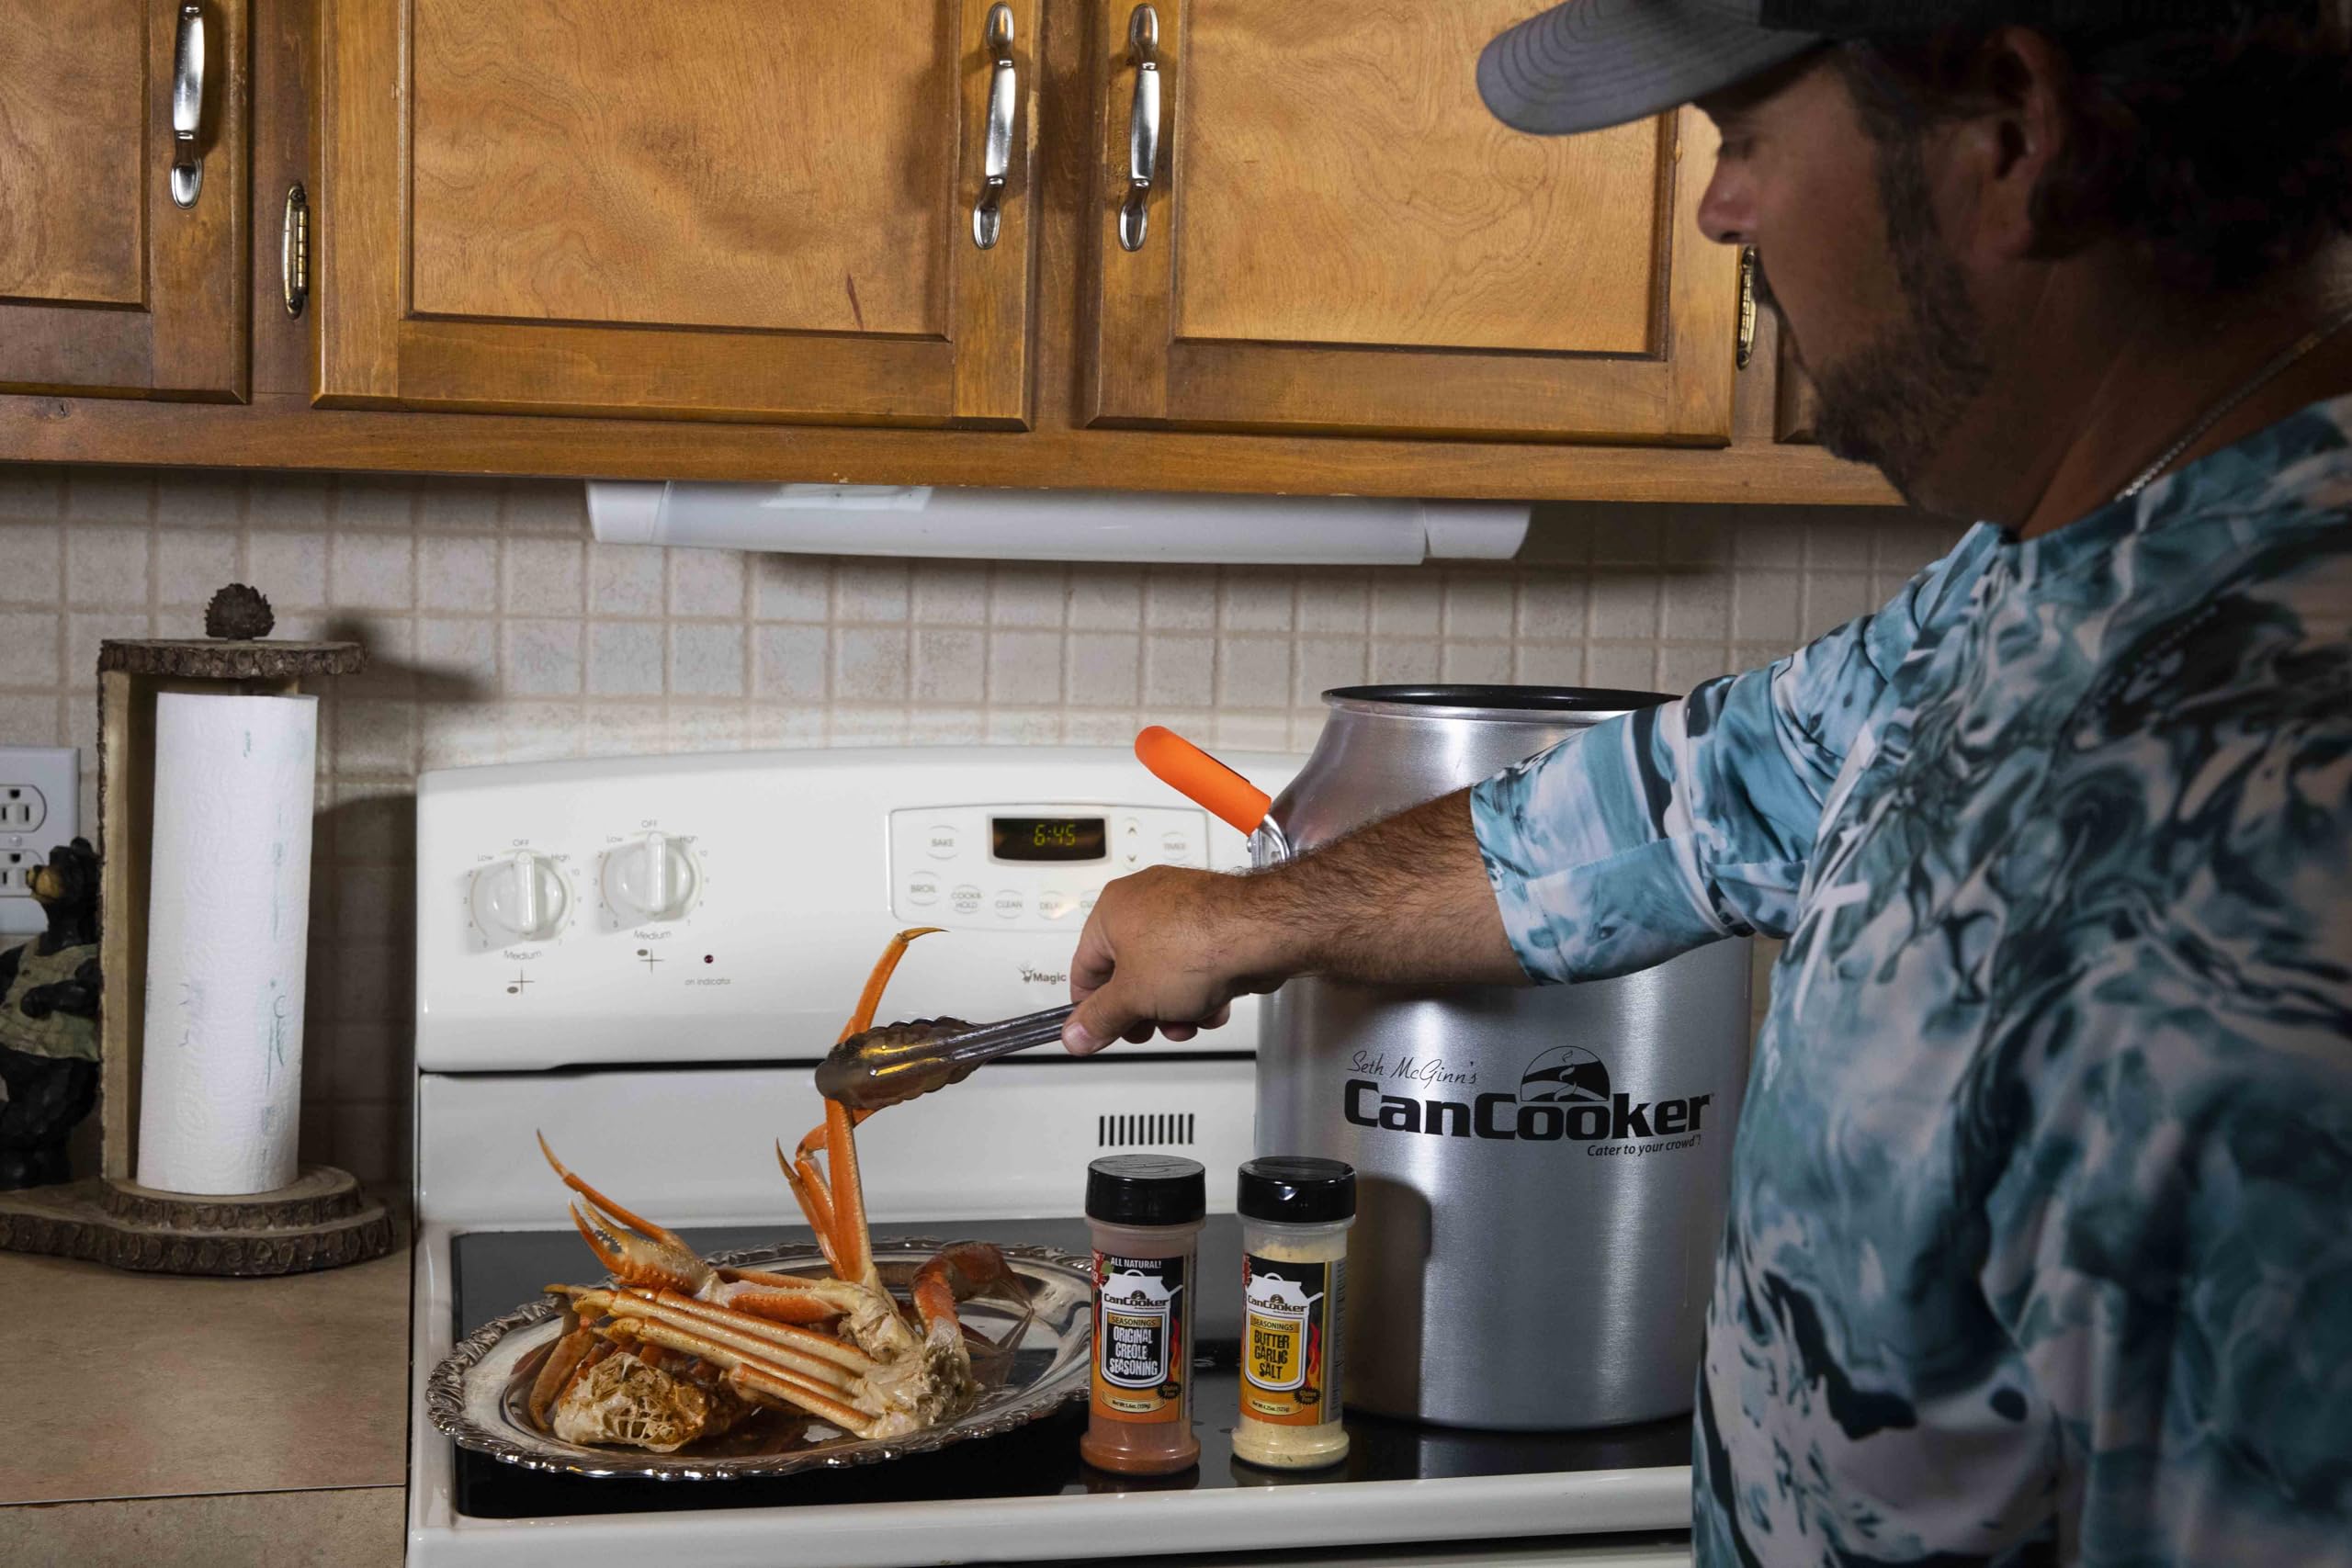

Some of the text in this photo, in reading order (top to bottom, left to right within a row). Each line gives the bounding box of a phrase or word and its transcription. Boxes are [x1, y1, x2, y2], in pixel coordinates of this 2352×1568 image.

[640, 819, 658, 829] OFF
[605, 834, 624, 843] Low
[1033, 824, 1077, 846] 6:45
[512, 838, 531, 847] OFF
[931, 838, 955, 848] BAKE
[477, 853, 495, 863] Low
[910, 884, 937, 894] BROIL
[994, 899, 1023, 909] CLEAN
[632, 929, 672, 941] Medium
[503, 950, 543, 962] Medium
[1032, 971, 1067, 985] Magic
[1347, 1049, 1478, 1089] Seth McGinn's
[1344, 1077, 1713, 1142] CanCooker
[1587, 1145, 1622, 1157] Cater
[1623, 1144, 1636, 1156] to
[1638, 1142, 1664, 1157] your
[1110, 1257, 1162, 1269] ALL NATURAL!
[1104, 1292, 1170, 1307] CanCooker
[1248, 1294, 1308, 1313] CanCooker
[1111, 1315, 1157, 1326] SEASONINGS
[1252, 1318, 1294, 1331] SEASONINGS
[1113, 1326, 1153, 1344] ORIGINAL
[1254, 1329, 1290, 1349] BUTTER
[1114, 1342, 1148, 1359] CREOLE
[1254, 1345, 1289, 1364] GARLIC
[1109, 1358, 1159, 1376] SEASONING
[1259, 1362, 1283, 1380] SALT
